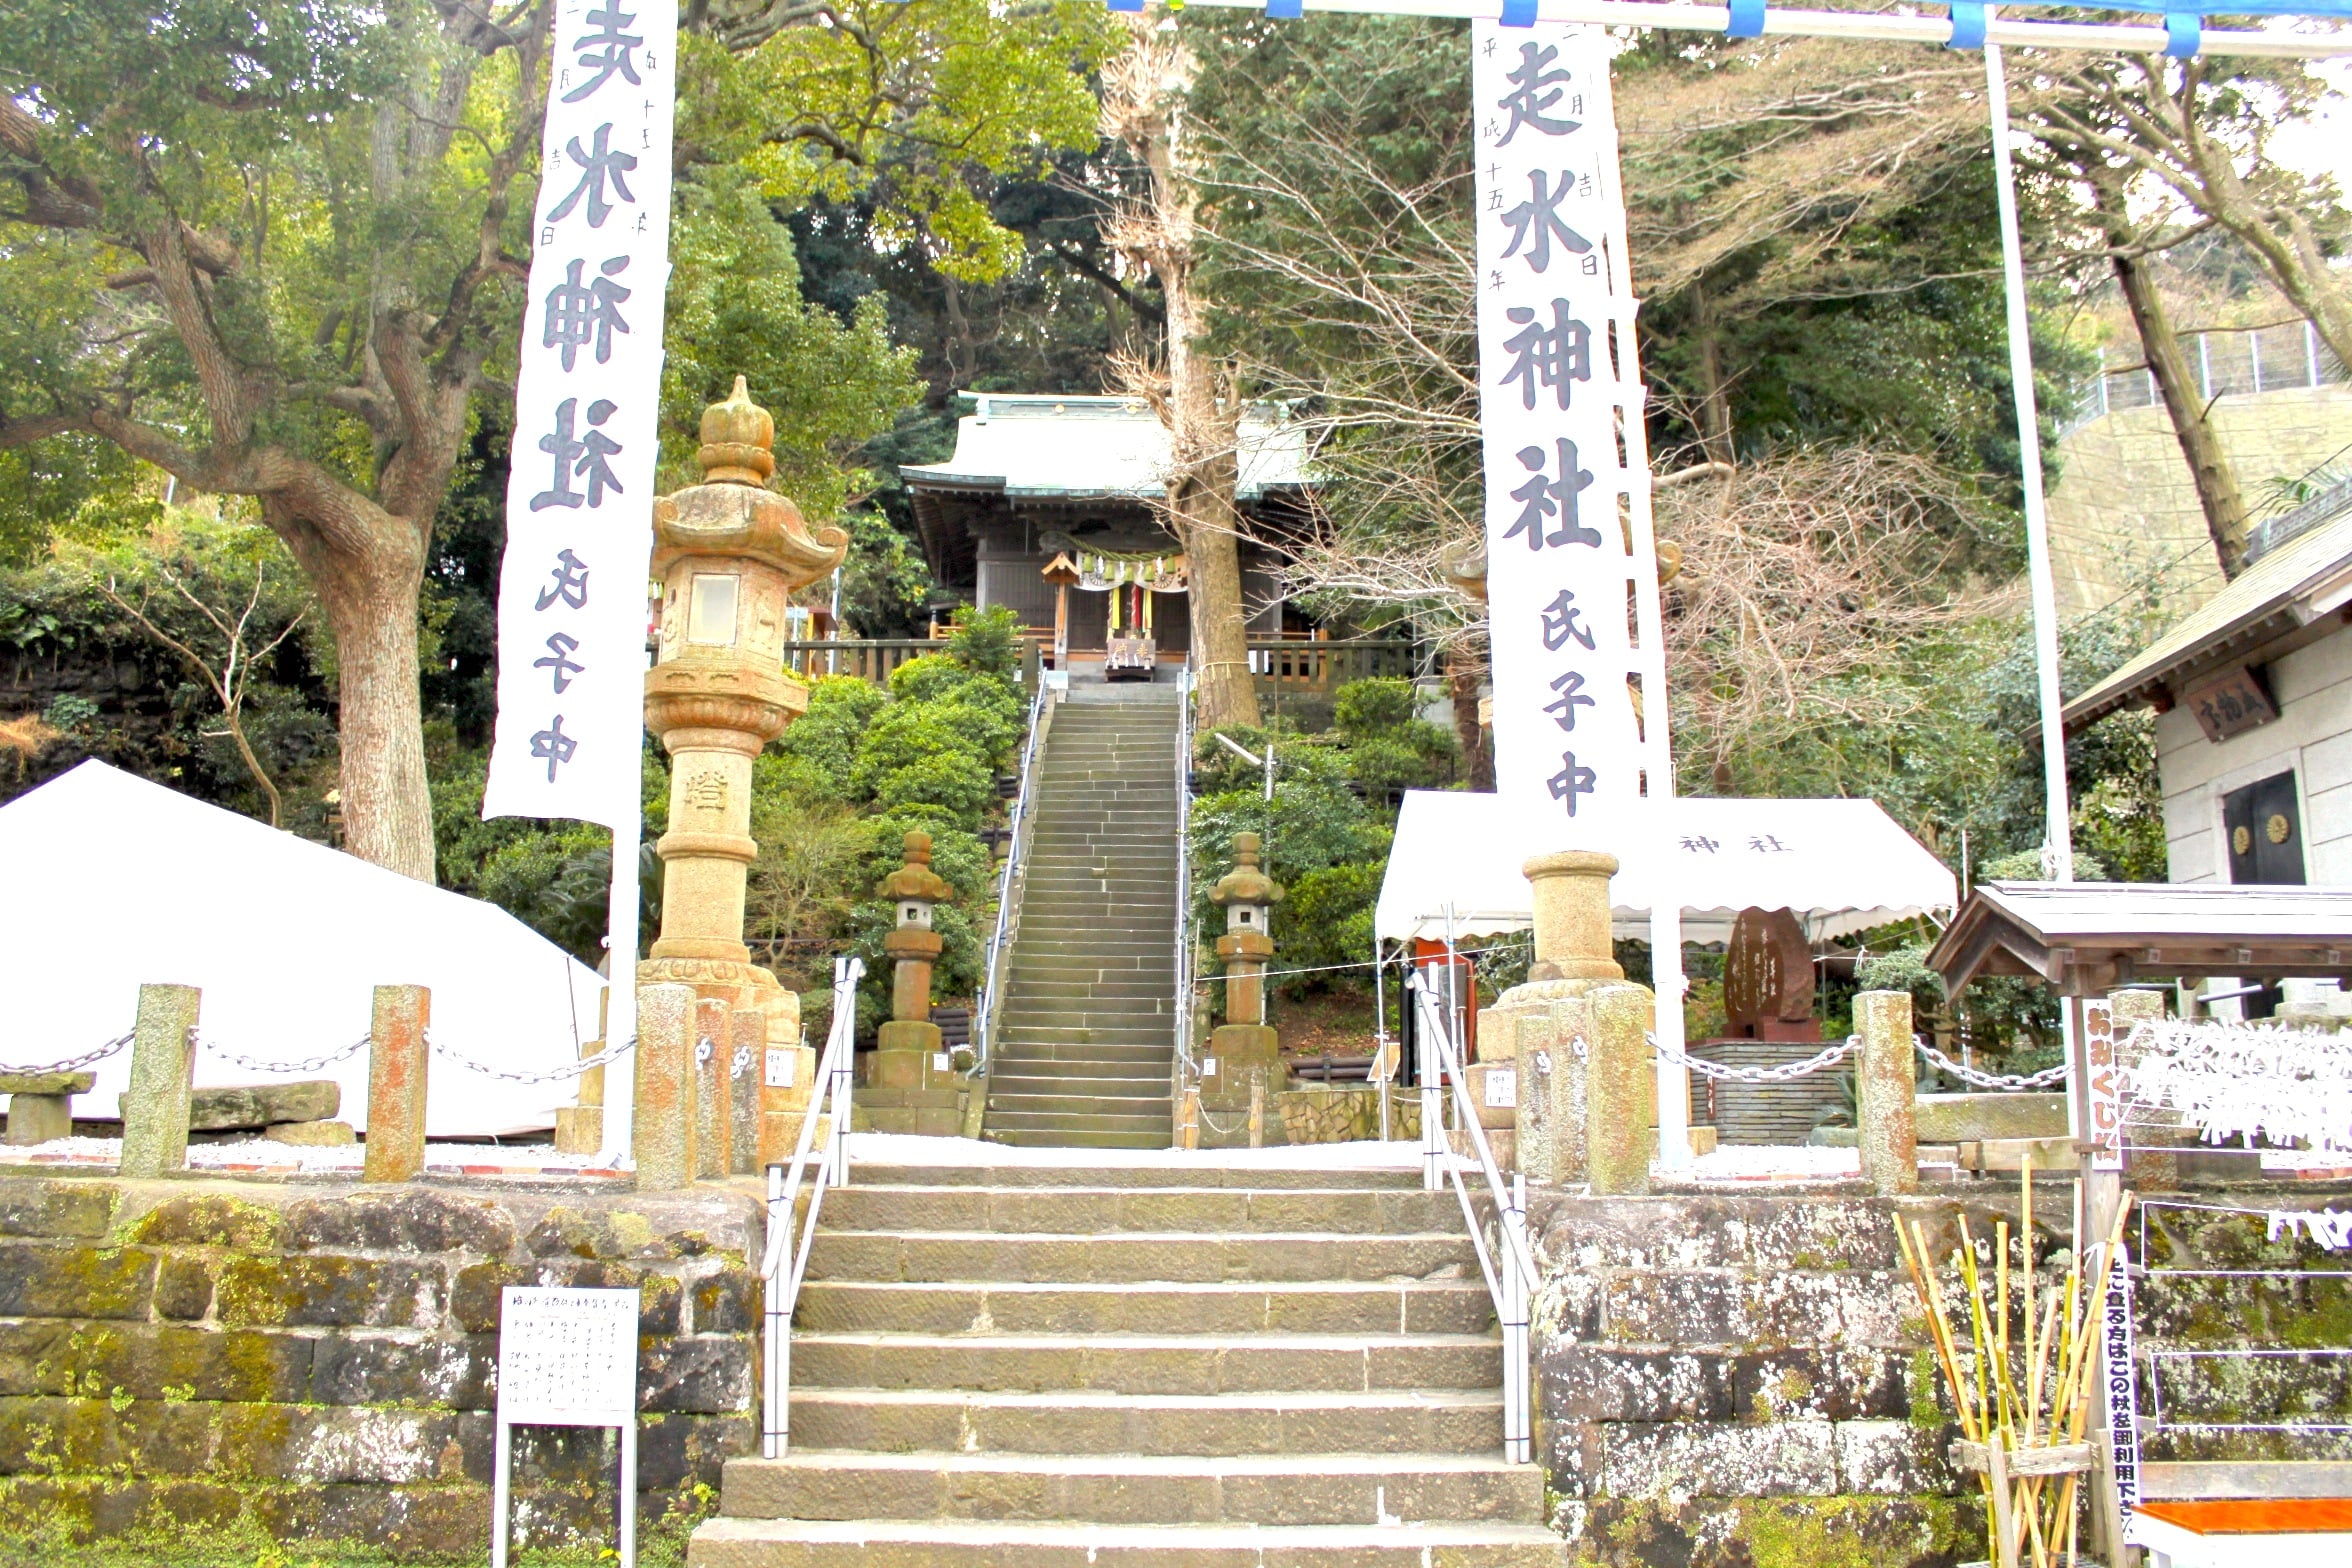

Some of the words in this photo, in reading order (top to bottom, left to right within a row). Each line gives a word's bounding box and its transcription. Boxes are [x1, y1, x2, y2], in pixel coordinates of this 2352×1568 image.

[1482, 37, 1506, 293] 平成十五年
[1494, 41, 1602, 818] 走水神社氏子中
[1679, 834, 1795, 855] 神社
